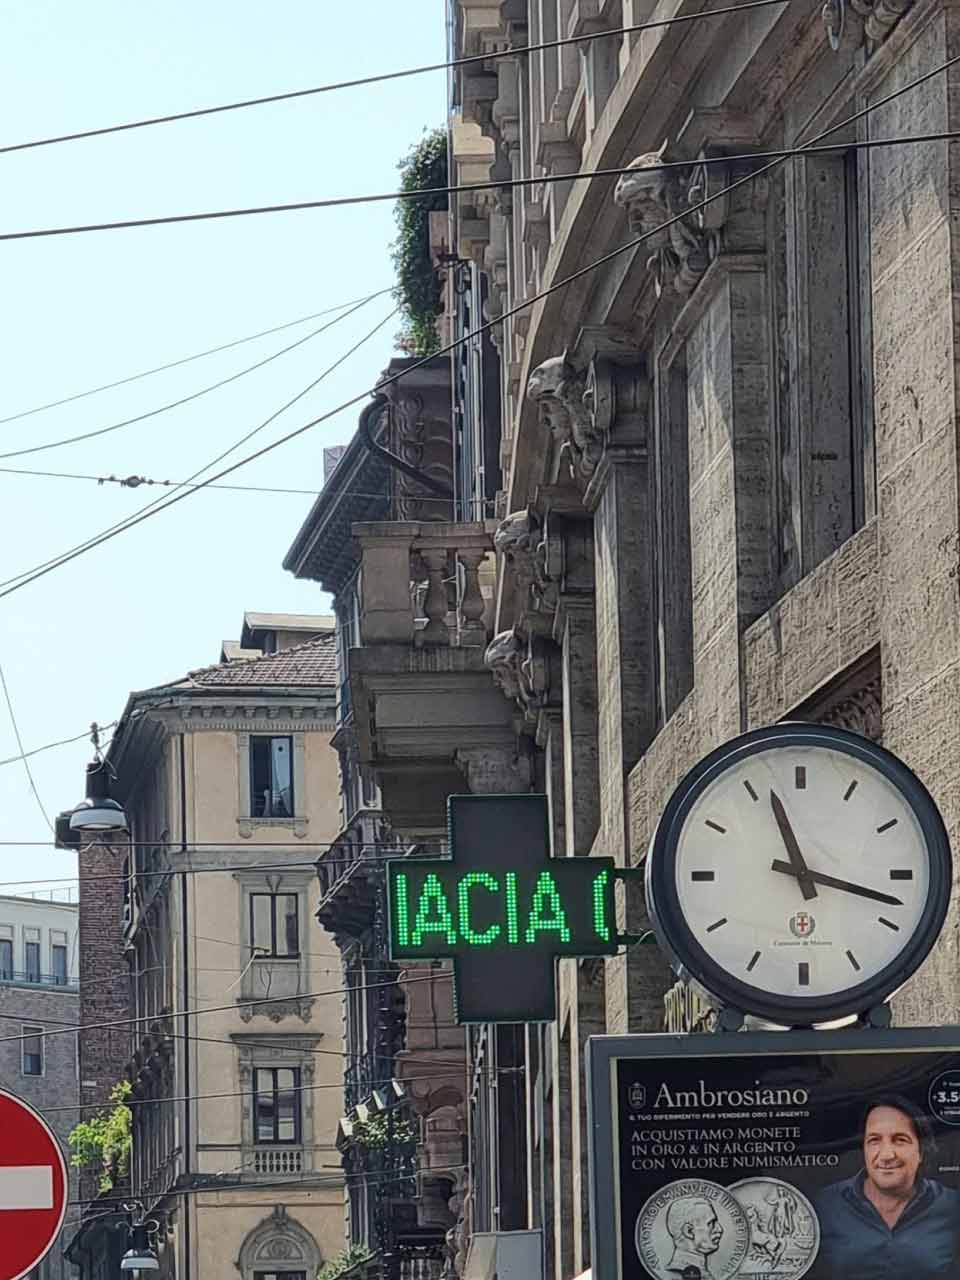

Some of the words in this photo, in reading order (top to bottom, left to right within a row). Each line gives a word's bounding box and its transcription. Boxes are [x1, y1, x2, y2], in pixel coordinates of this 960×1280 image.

[653, 1080, 808, 1108] Ambrosiano
[932, 1091, 960, 1103] +3.5
[631, 1128, 734, 1142] ACQUISTIAMO
[738, 1127, 801, 1138] MONETE
[632, 1145, 647, 1156] IN
[651, 1143, 685, 1156] ORO
[704, 1143, 719, 1154] IN
[722, 1141, 796, 1154] ARGENTO
[631, 1158, 665, 1170] CON
[671, 1157, 729, 1169] VALORE
[732, 1154, 839, 1168] NUMISMATICO
